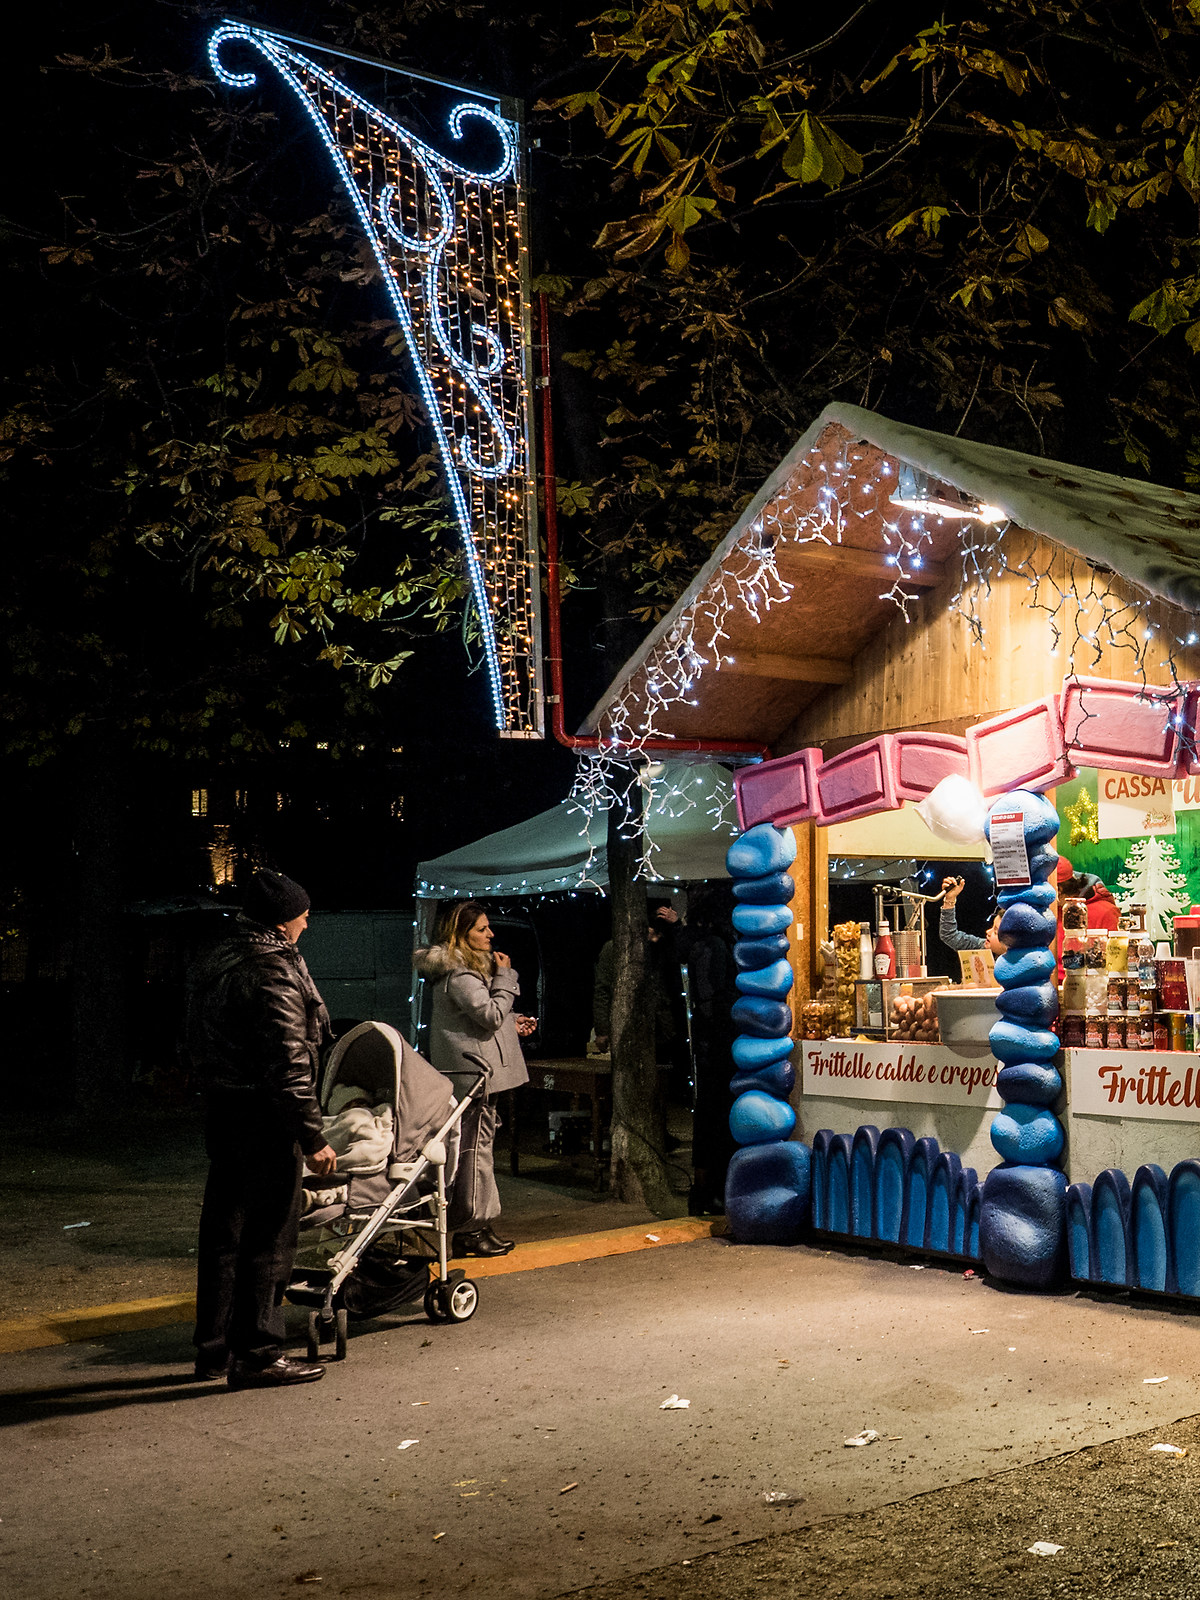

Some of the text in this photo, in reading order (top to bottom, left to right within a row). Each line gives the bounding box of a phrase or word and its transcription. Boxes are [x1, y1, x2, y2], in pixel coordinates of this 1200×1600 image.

[1104, 775, 1166, 800] CASSA
[808, 1051, 874, 1080] Frittelle
[875, 1055, 927, 1082] calde
[927, 1064, 939, 1084] e
